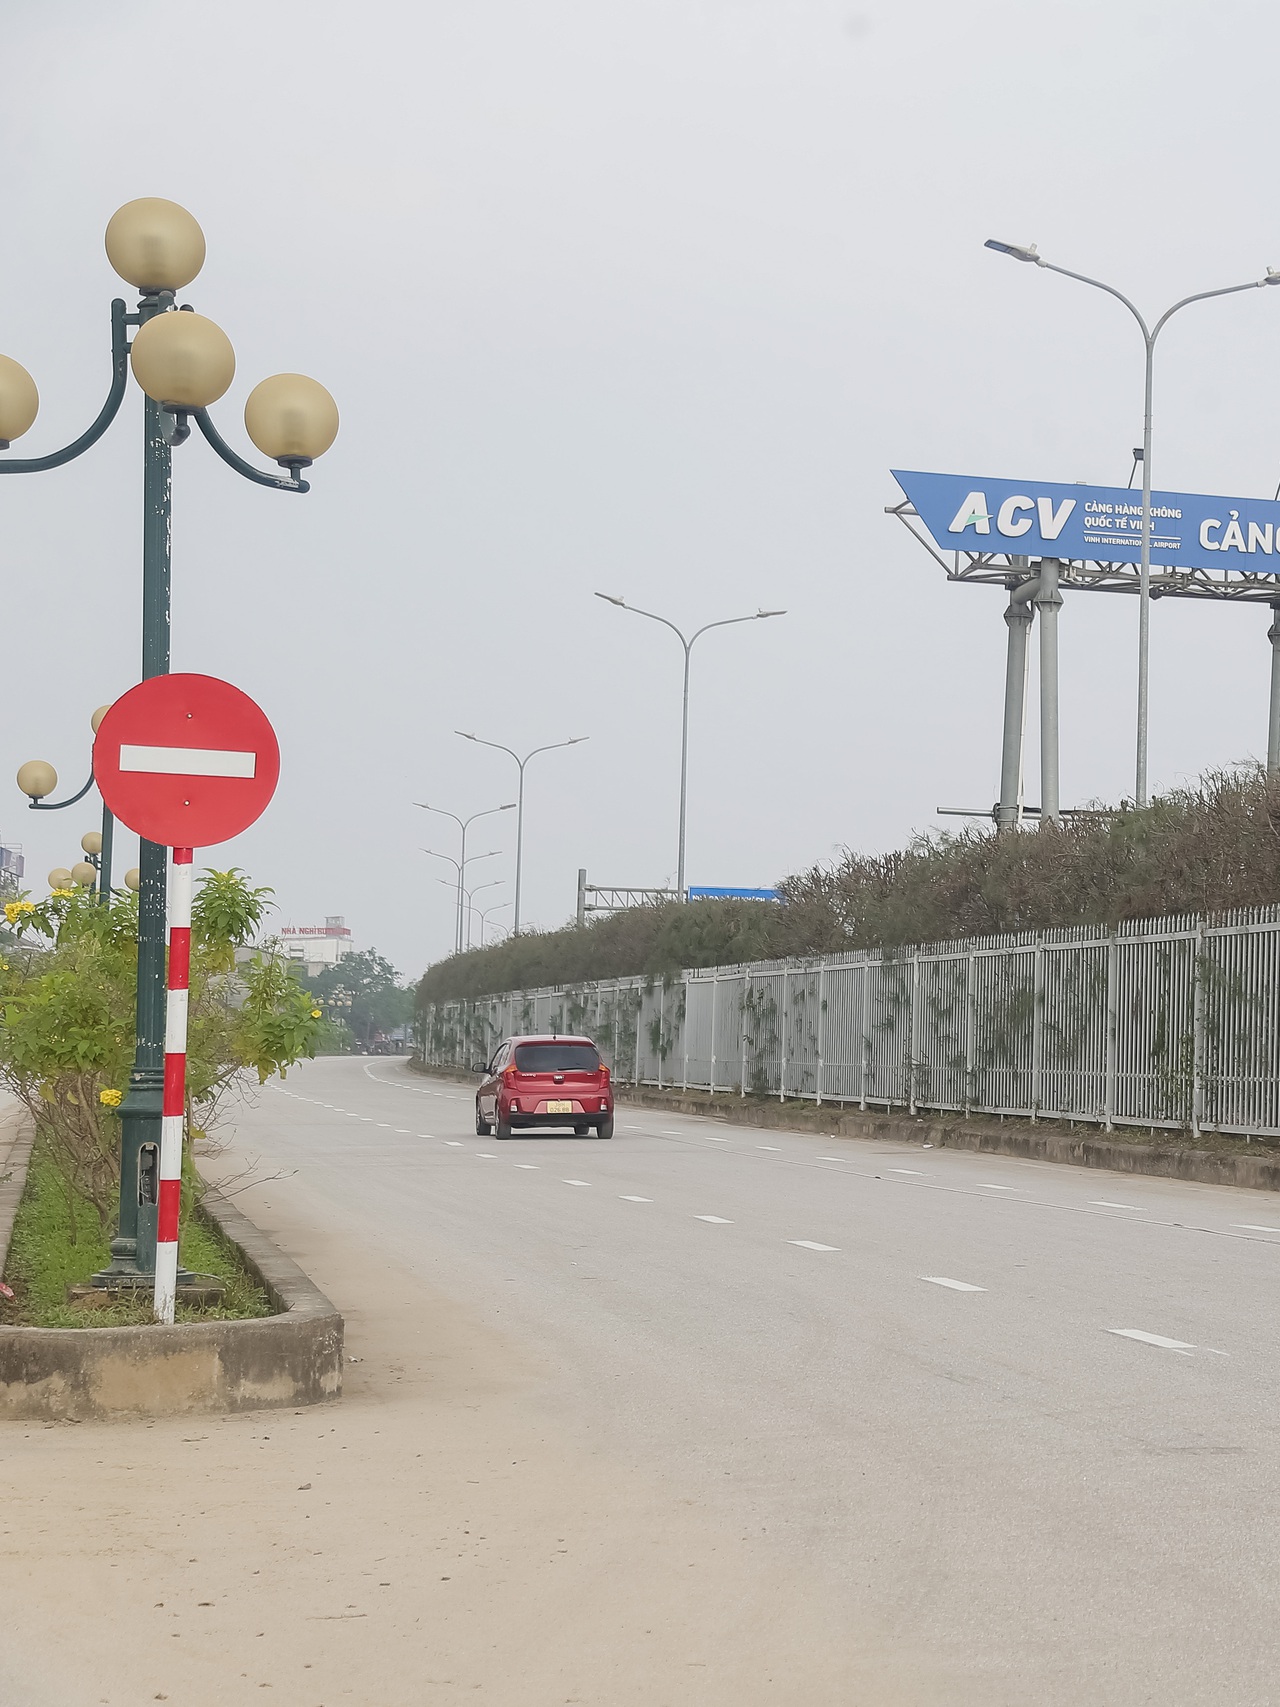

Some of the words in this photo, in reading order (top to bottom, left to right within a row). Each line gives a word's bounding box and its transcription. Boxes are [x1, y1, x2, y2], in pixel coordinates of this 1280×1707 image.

[948, 491, 1077, 540] ACV
[1085, 500, 1113, 514] CẢNG
[1115, 503, 1143, 516] HÀNG
[1084, 515, 1112, 528] QUỐC
[1115, 516, 1128, 529] TẾ
[1084, 535, 1100, 544] VINH
[1153, 541, 1181, 550] AIRPORT
